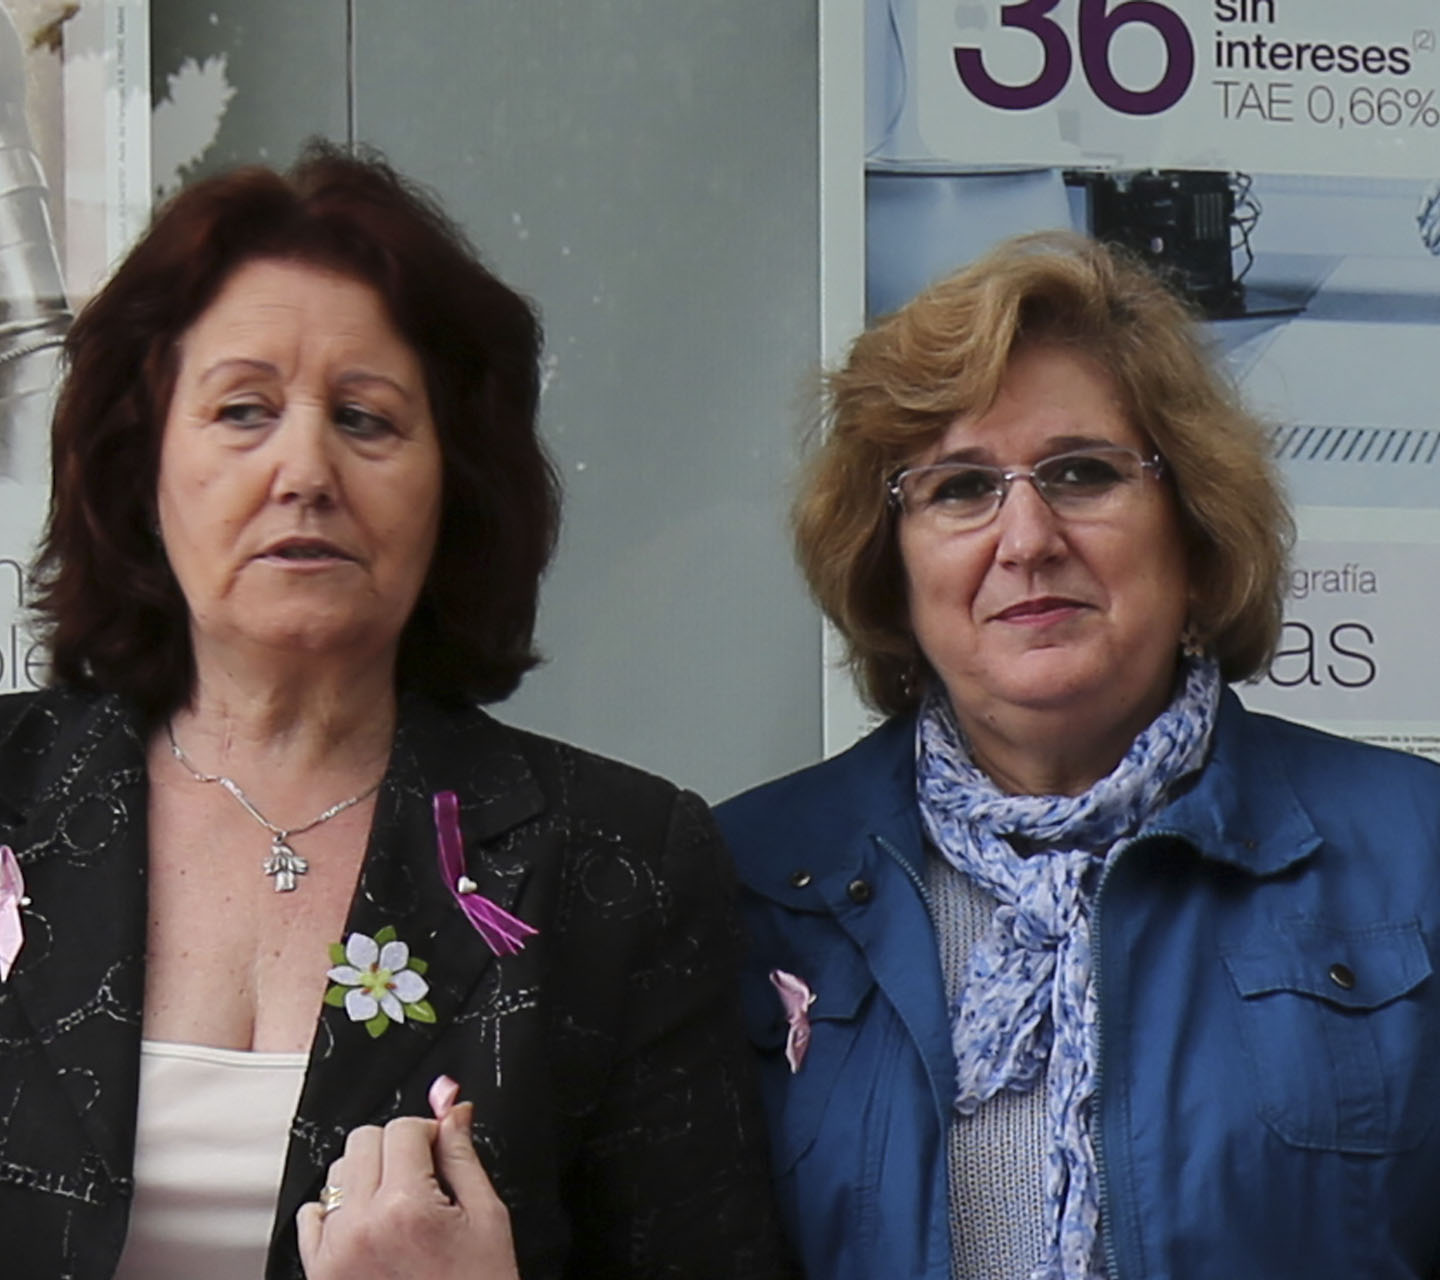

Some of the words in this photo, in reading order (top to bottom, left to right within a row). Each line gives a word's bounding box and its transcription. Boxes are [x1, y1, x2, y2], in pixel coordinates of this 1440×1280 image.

[953, 0, 1195, 116] 36
[1215, 32, 1412, 75] intereses
[1212, 80, 1295, 123] TAE
[1307, 86, 1440, 128] 0,66%
[1288, 563, 1378, 600] grafía
